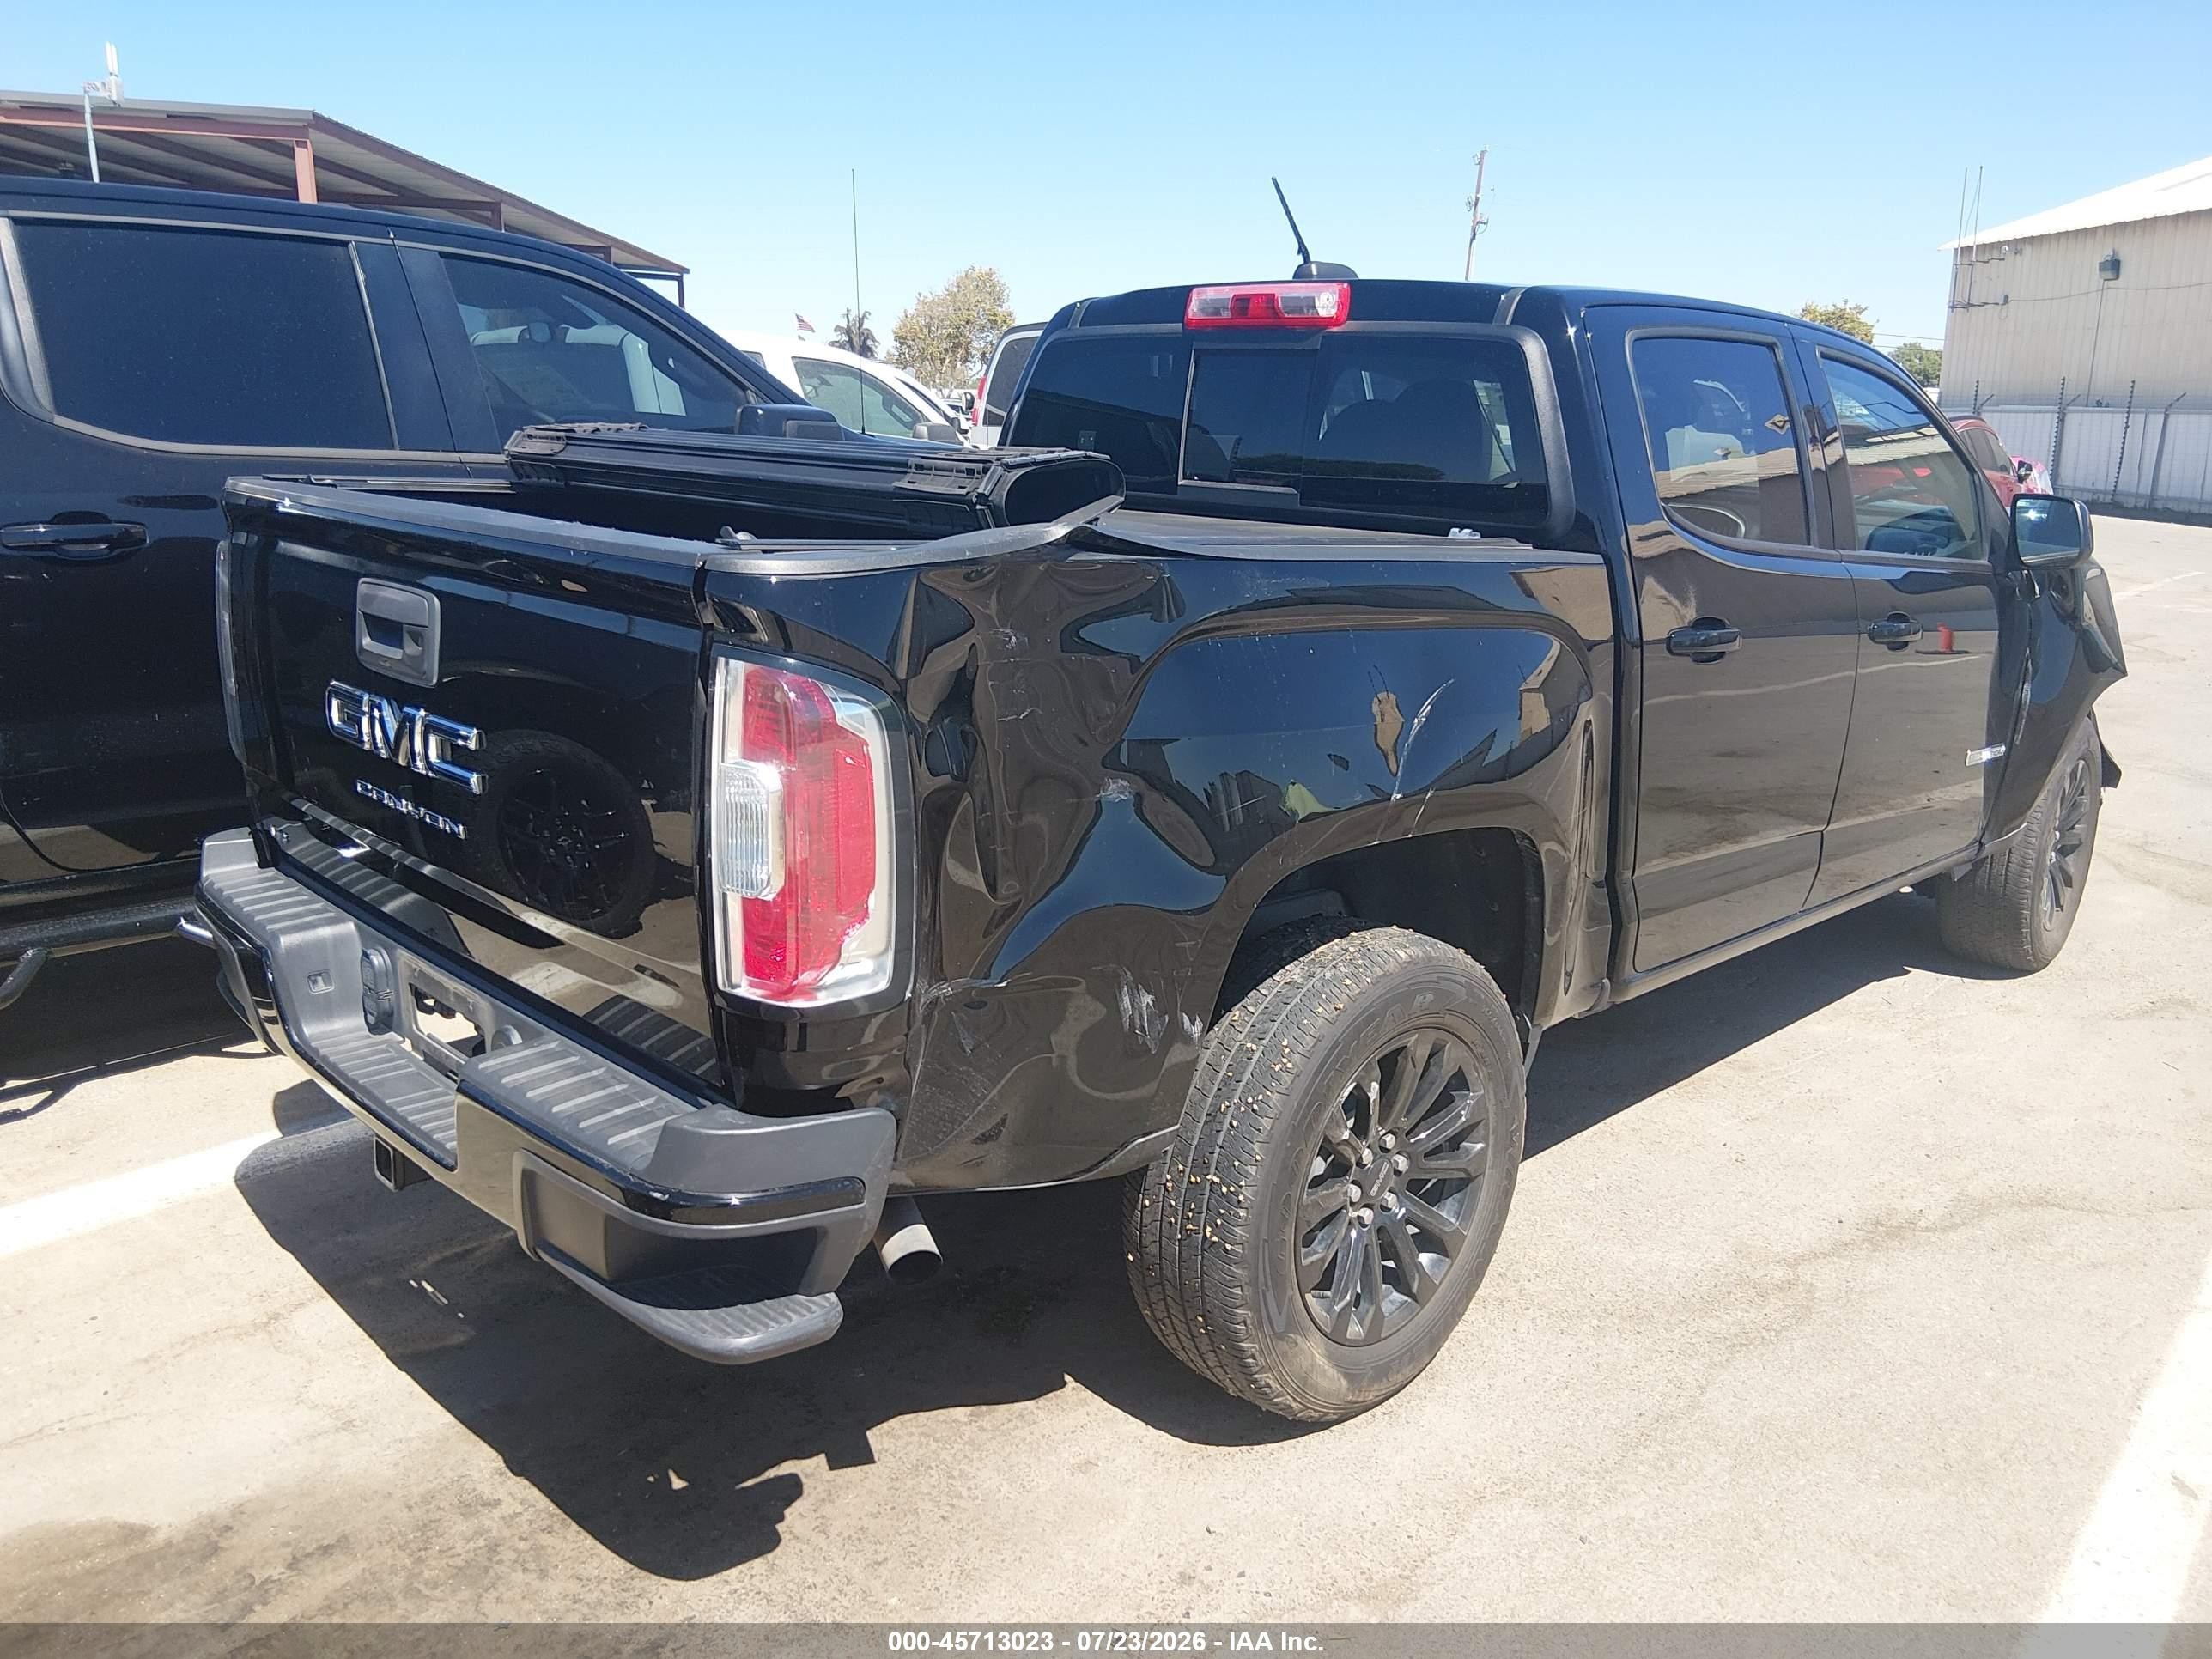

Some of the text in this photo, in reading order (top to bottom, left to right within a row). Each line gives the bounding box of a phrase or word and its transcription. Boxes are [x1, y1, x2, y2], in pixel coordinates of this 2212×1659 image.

[325, 680, 488, 795] GMC
[356, 778, 467, 840] CANYON
[1370, 1161, 1389, 1197] GMC
